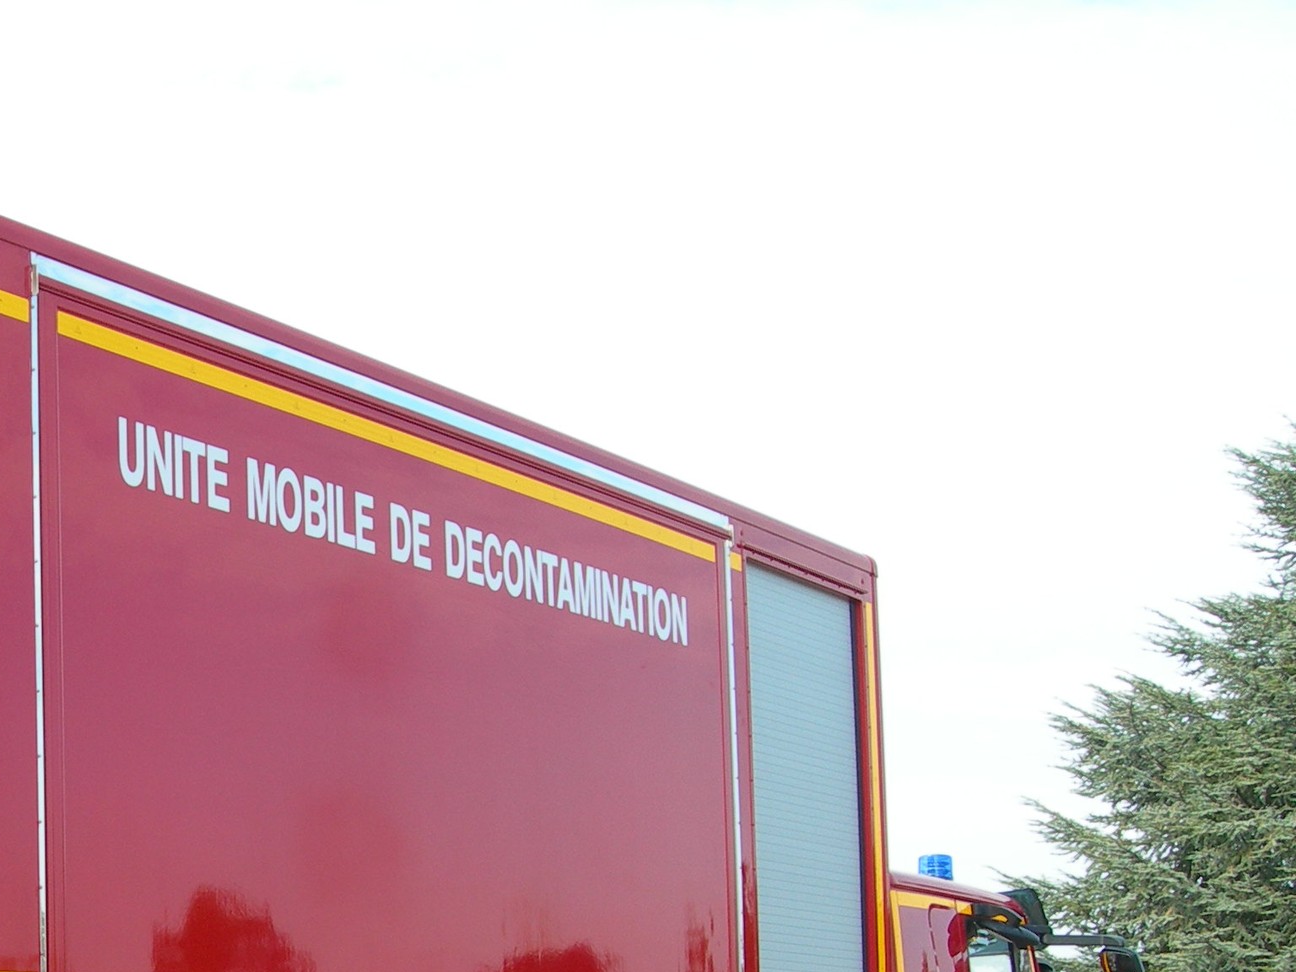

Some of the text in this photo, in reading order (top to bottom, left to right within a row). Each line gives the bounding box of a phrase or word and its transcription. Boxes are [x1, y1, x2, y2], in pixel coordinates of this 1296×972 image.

[118, 416, 688, 646] UNITE MOBILE DE DECONTAMINATION
